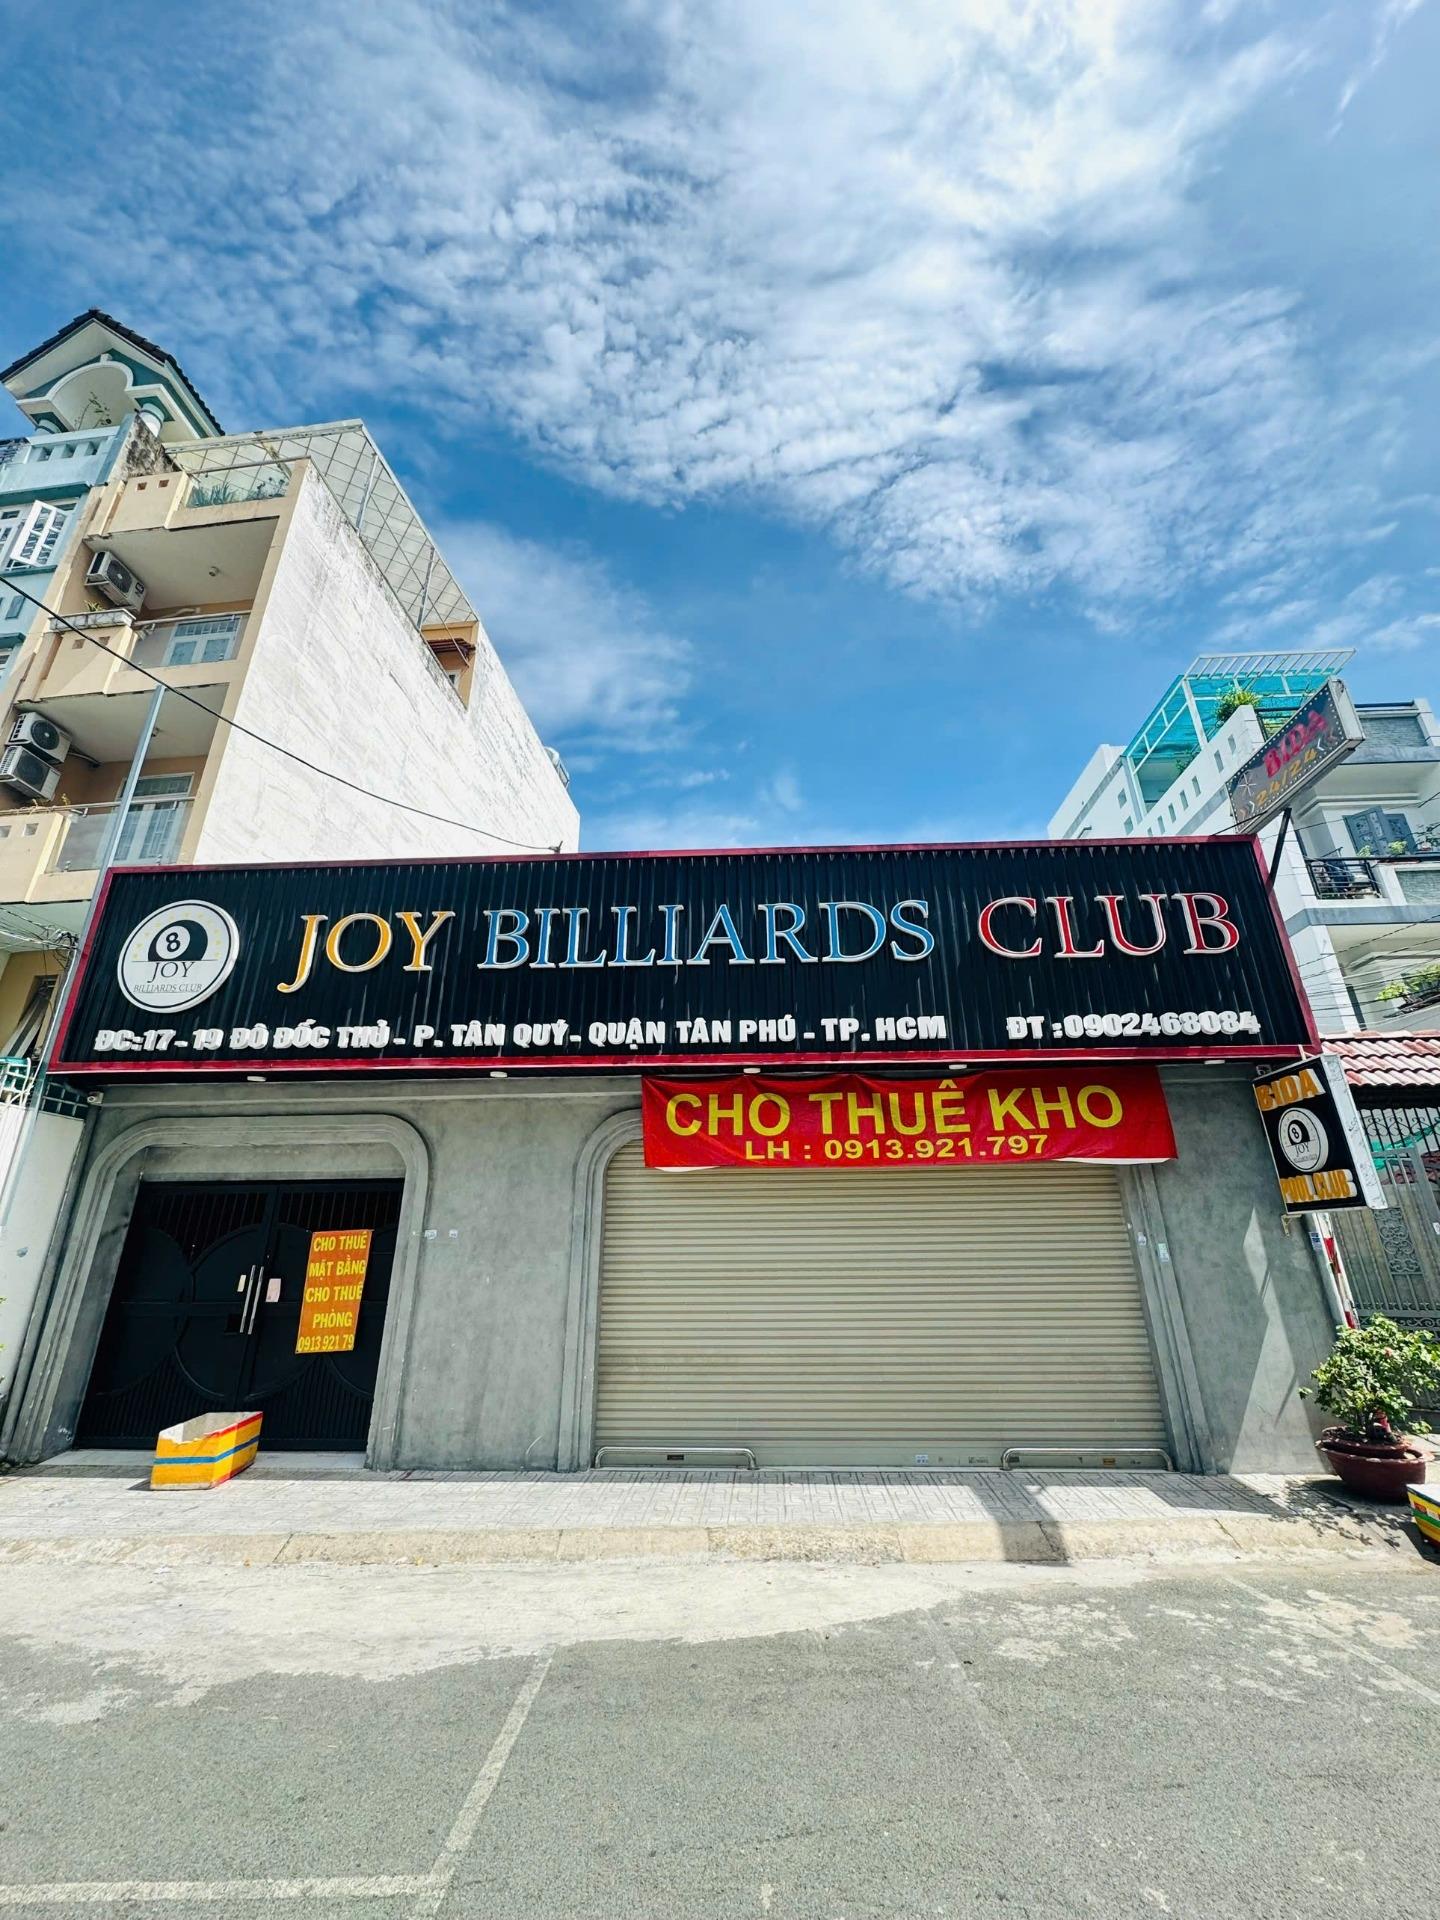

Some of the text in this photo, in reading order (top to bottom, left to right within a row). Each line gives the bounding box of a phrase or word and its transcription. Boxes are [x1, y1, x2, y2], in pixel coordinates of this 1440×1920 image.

[1264, 711, 1327, 777] BIDA
[166, 932, 180, 952] 8
[277, 892, 1240, 993] JOY BILLIARDS CLUB
[147, 961, 195, 984] JOY
[133, 983, 202, 993] BILLIARDS CLUB
[229, 1023, 269, 1050] ĐÔ
[272, 1018, 331, 1049] ĐỐC
[336, 1019, 391, 1049] THỦ
[450, 1019, 506, 1047] TÂN
[588, 1017, 666, 1050] QUẬN
[675, 1017, 732, 1044] TÂN
[739, 1014, 796, 1043] PHÚ
[1006, 1015, 1045, 1040] ĐT
[1255, 1069, 1326, 1111] BIDA
[665, 1079, 1123, 1137] CHO THUÊ KHO
[745, 1140, 790, 1160] LH
[824, 1134, 1048, 1159] 0913.921.797
[1294, 1143, 1310, 1157] JOY
[1280, 1168, 1358, 1203] POOL CLUB
[313, 1231, 368, 1252] CHO THUÊ
[308, 1254, 366, 1281] MẶT BẰNG
[305, 1286, 331, 1303] CHO
[312, 1308, 353, 1329] PHÒNG
